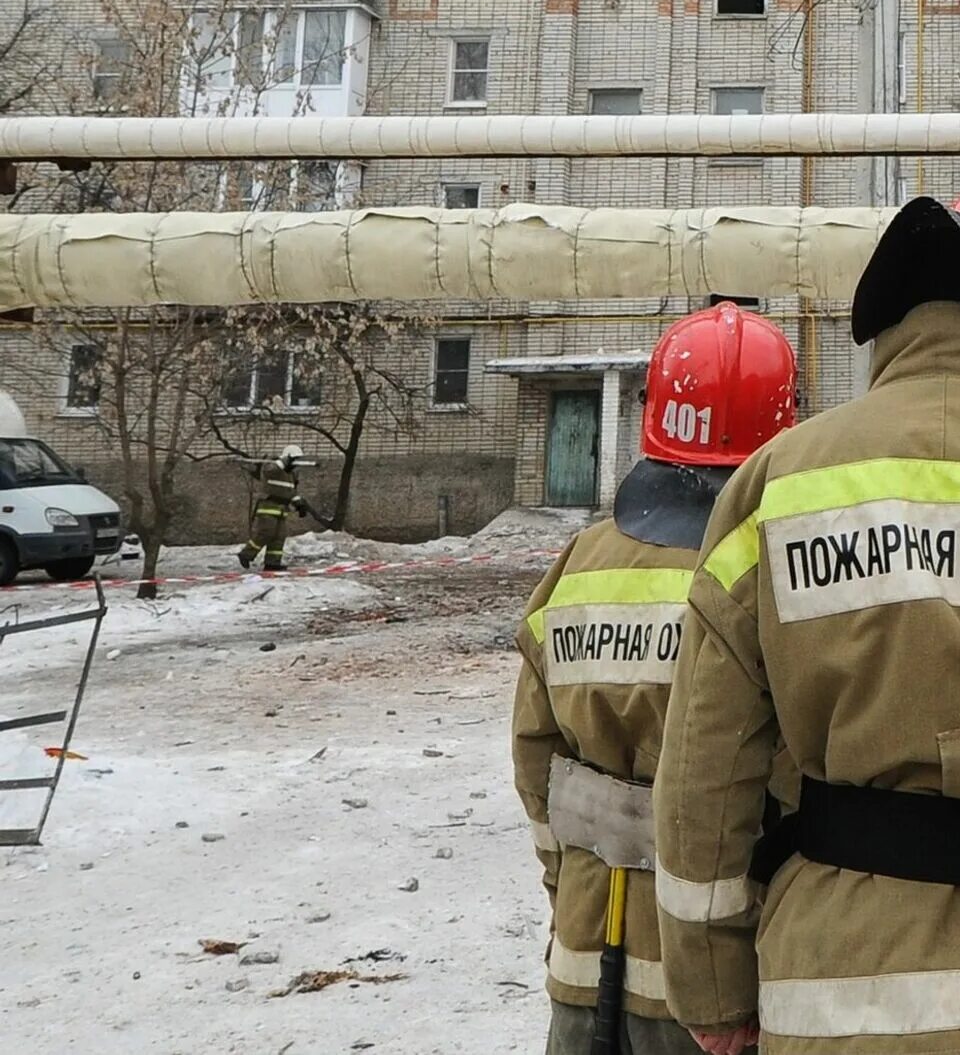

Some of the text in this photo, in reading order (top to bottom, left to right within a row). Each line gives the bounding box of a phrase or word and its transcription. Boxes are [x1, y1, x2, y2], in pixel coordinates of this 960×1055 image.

[662, 399, 712, 444] 401
[786, 524, 955, 591] ПОЖАРНАЯ
[552, 623, 652, 663] ПОЖАРНАЯ
